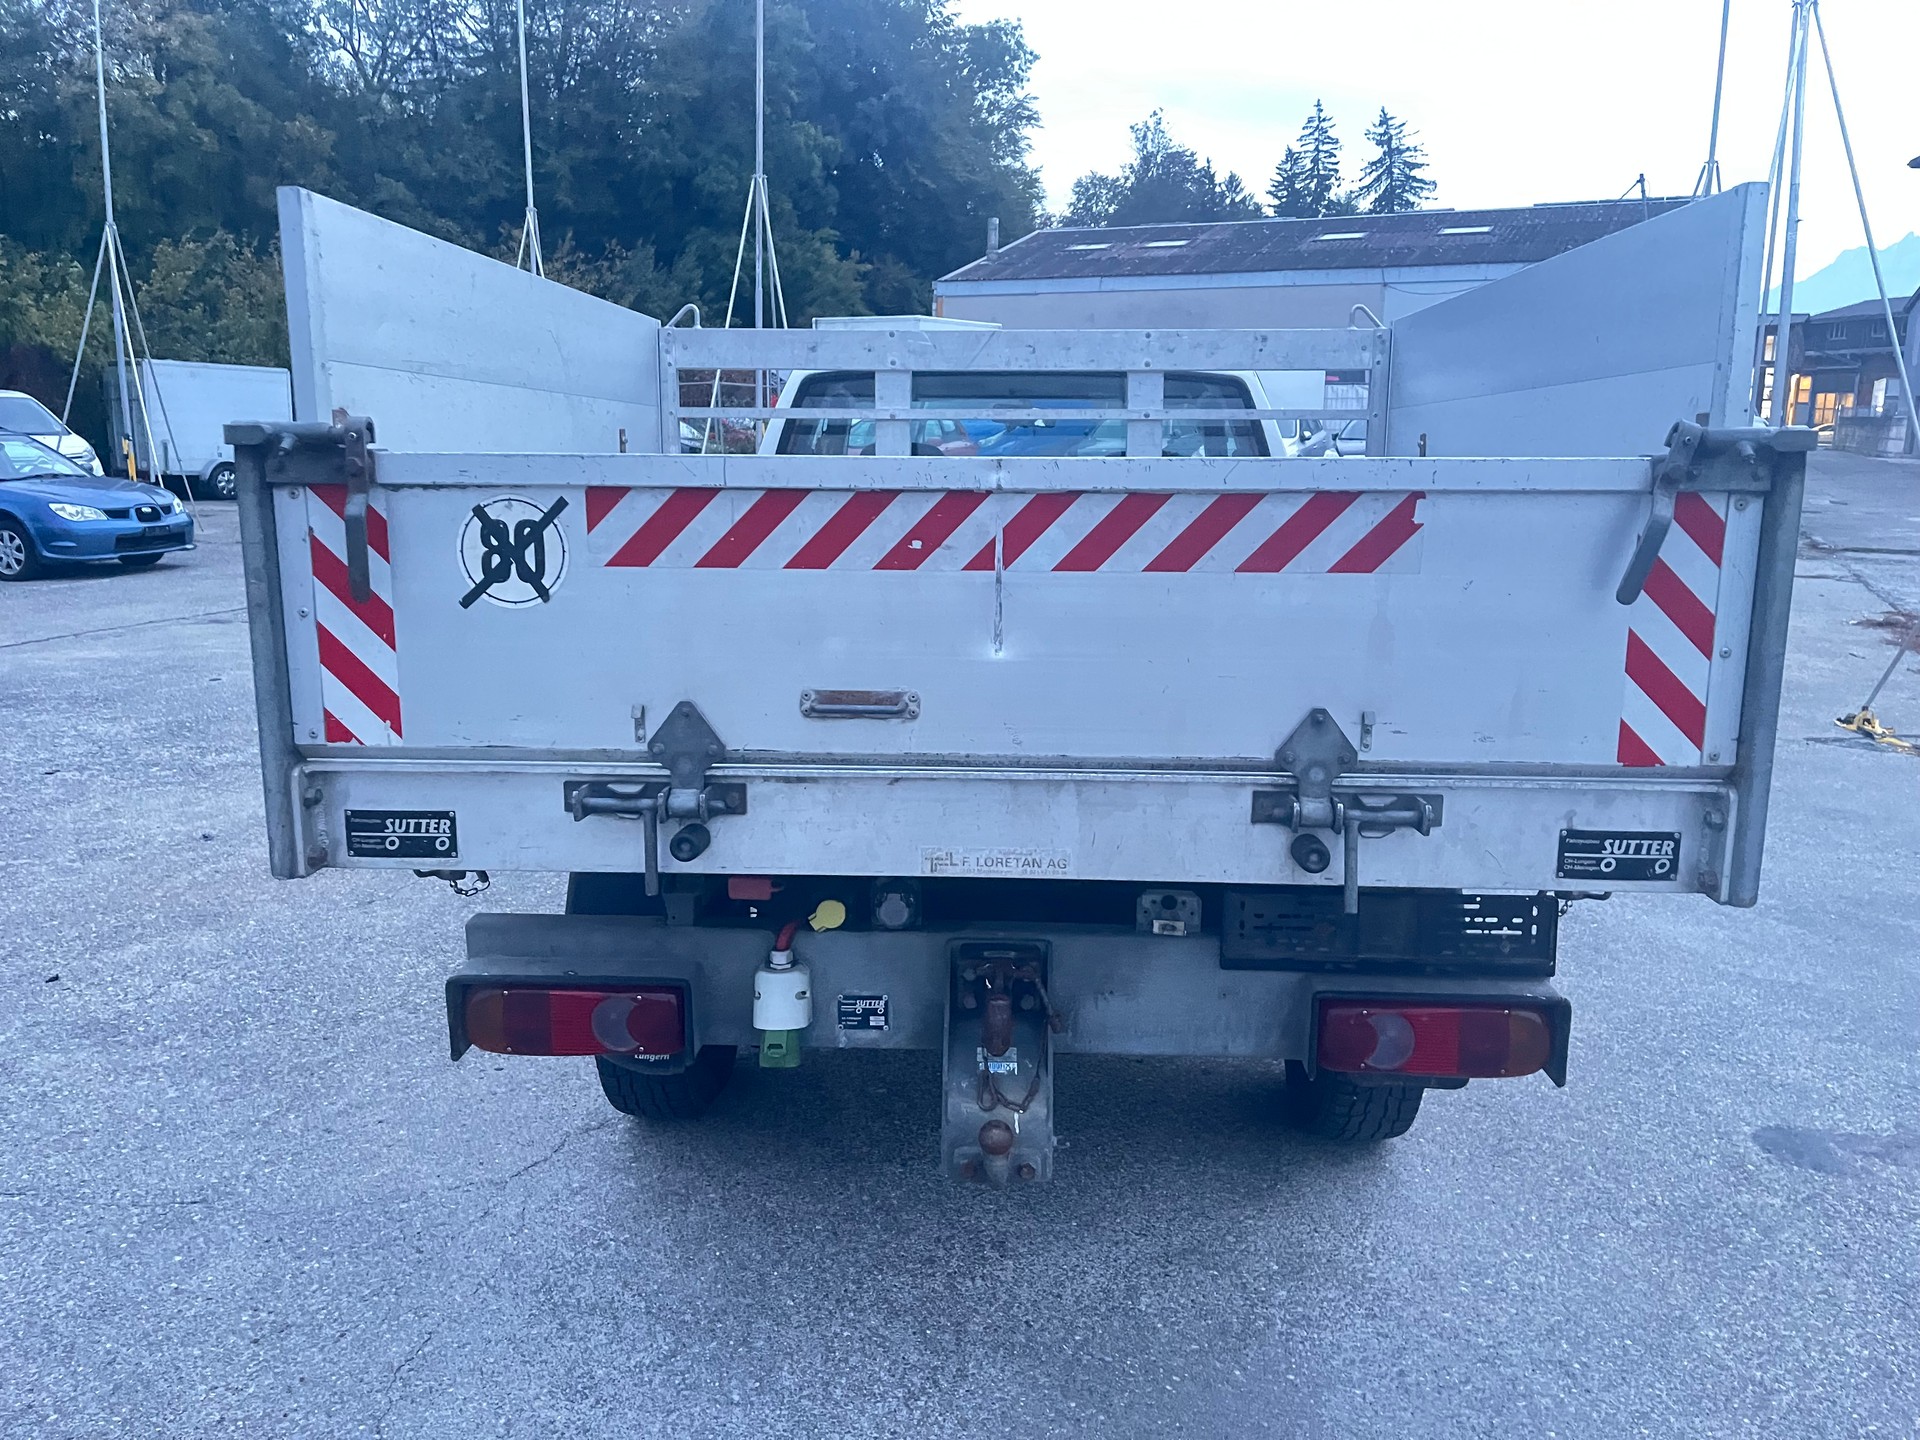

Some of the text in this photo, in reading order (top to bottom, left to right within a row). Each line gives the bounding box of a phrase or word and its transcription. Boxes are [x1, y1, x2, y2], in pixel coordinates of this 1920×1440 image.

[384, 818, 451, 834] SUTTER
[1601, 838, 1675, 856] SUTTER
[976, 856, 1042, 869] LORETAN
[1047, 858, 1068, 870] AG
[856, 1000, 885, 1008] SUTTER
